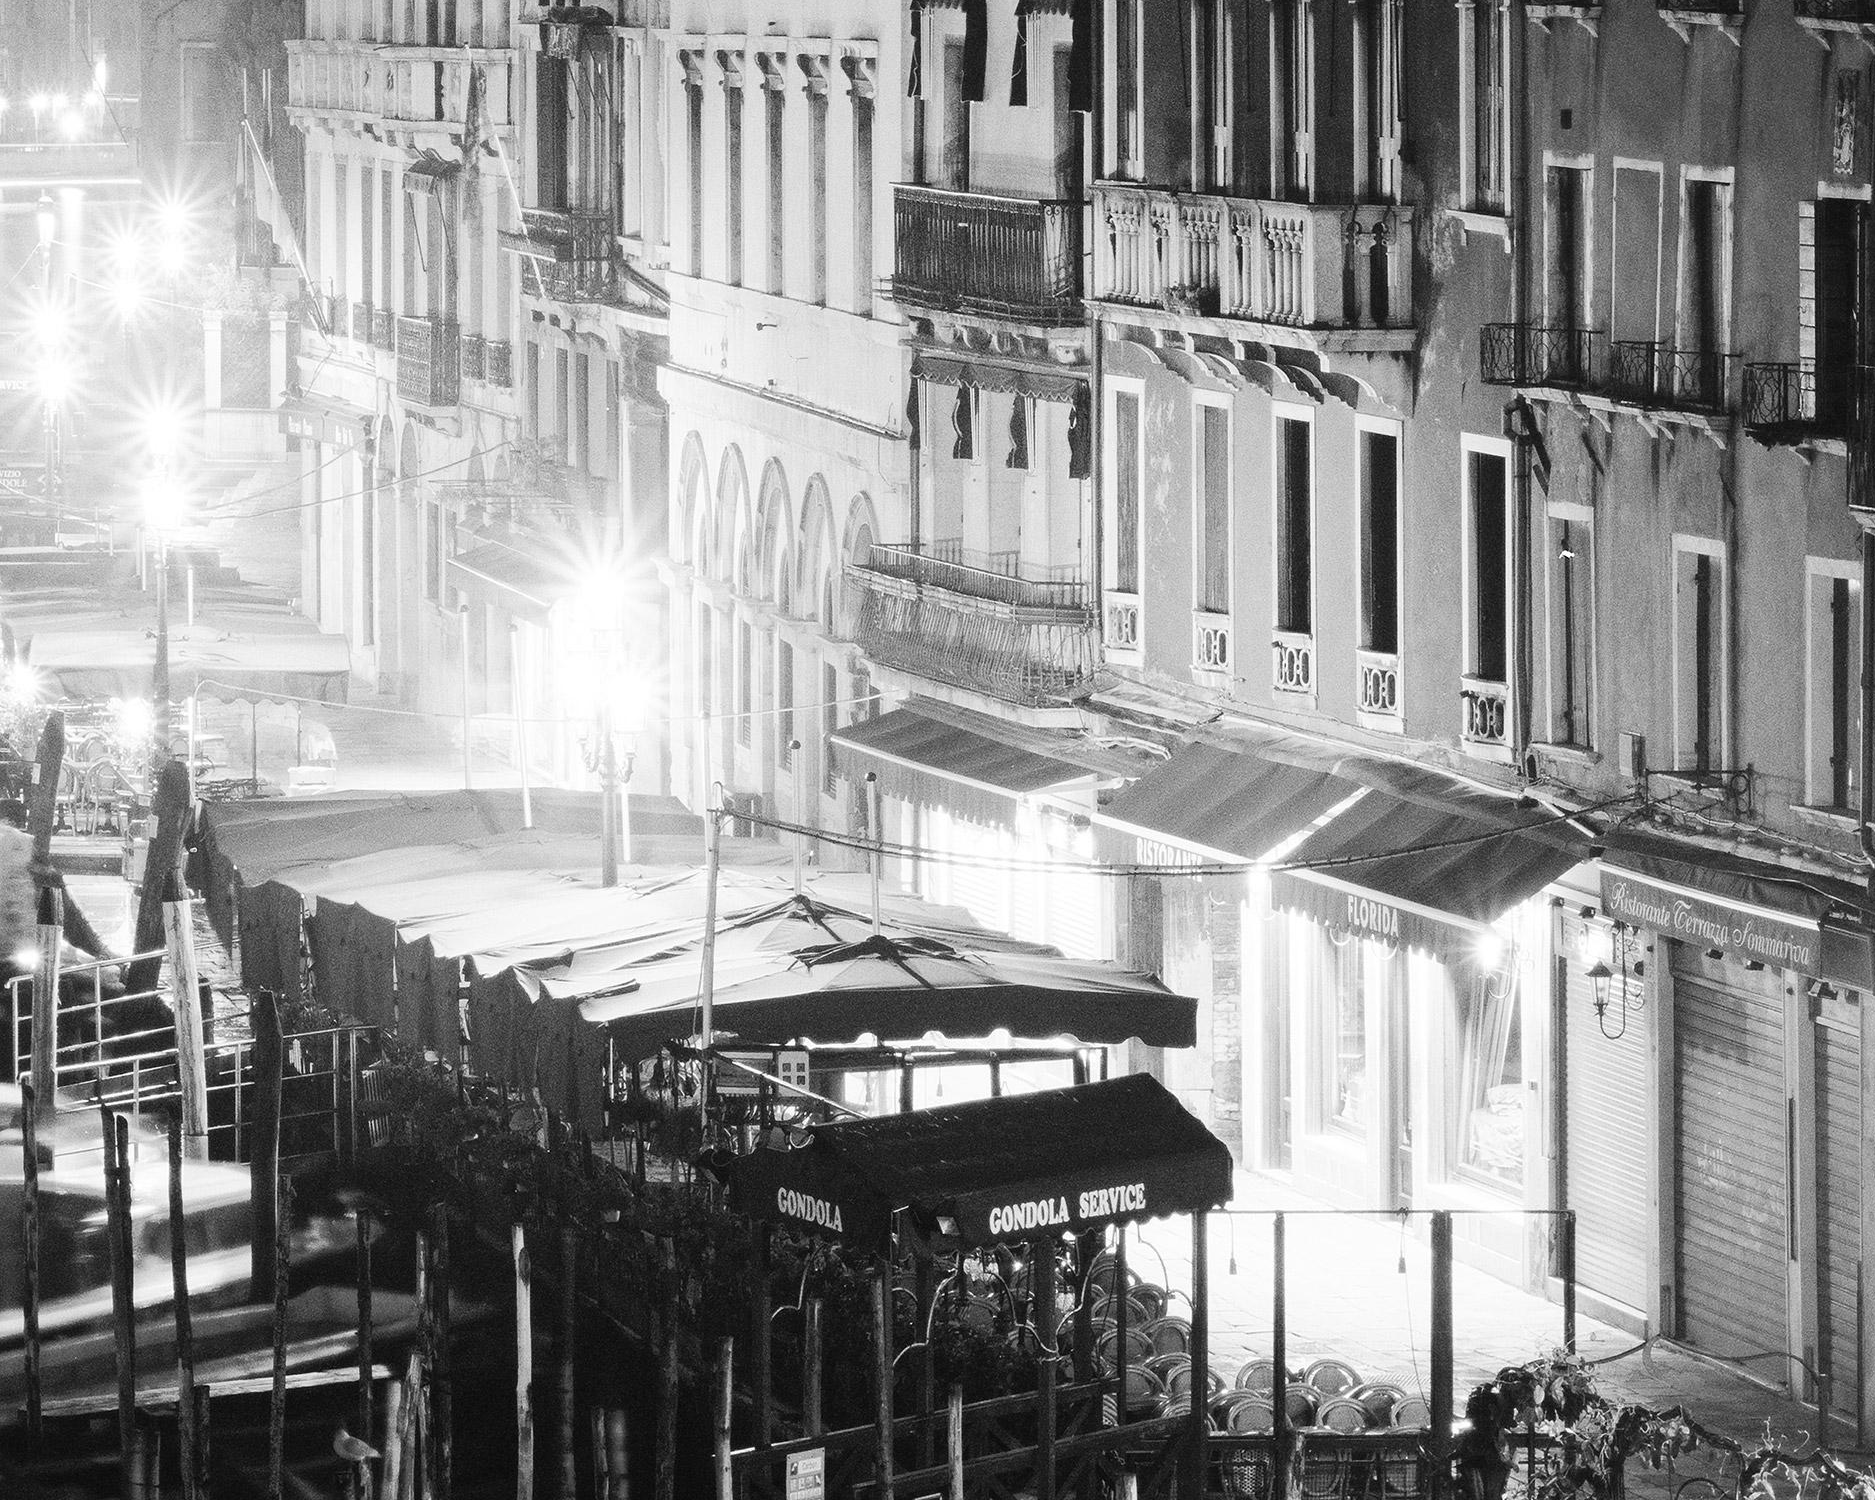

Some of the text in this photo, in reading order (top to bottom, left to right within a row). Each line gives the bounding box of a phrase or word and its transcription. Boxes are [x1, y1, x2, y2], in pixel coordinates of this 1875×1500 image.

[1347, 896, 1398, 937] FLORIDA
[1610, 882, 1671, 927] Ristorante
[1673, 900, 1729, 947] Terrazza
[1732, 921, 1810, 964] Sommariva
[777, 1187, 842, 1232] GONDOLA
[989, 1183, 1146, 1235] GONDOLA SERVICE
